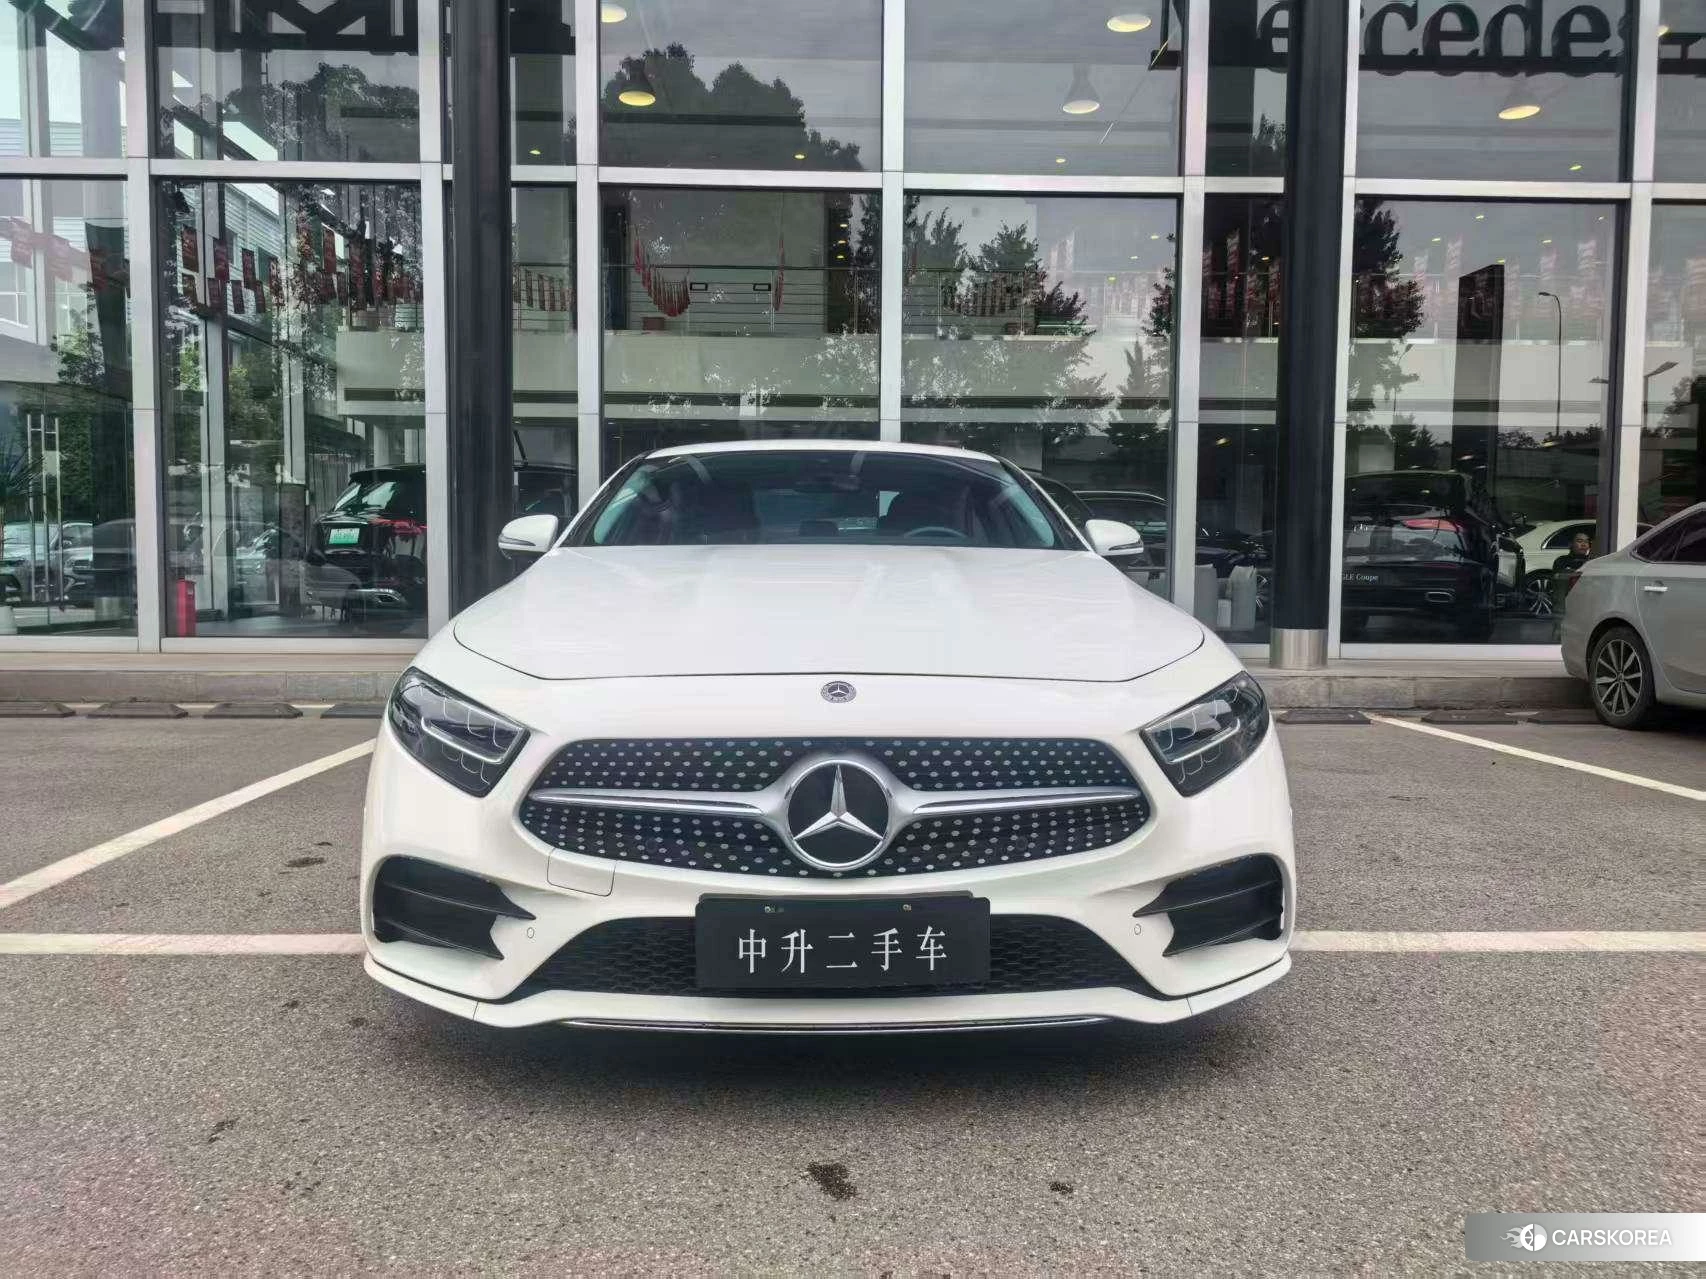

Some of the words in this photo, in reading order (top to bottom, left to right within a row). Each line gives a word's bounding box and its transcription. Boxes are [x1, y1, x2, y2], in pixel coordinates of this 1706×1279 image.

[738, 925, 948, 974] 中升二手车
